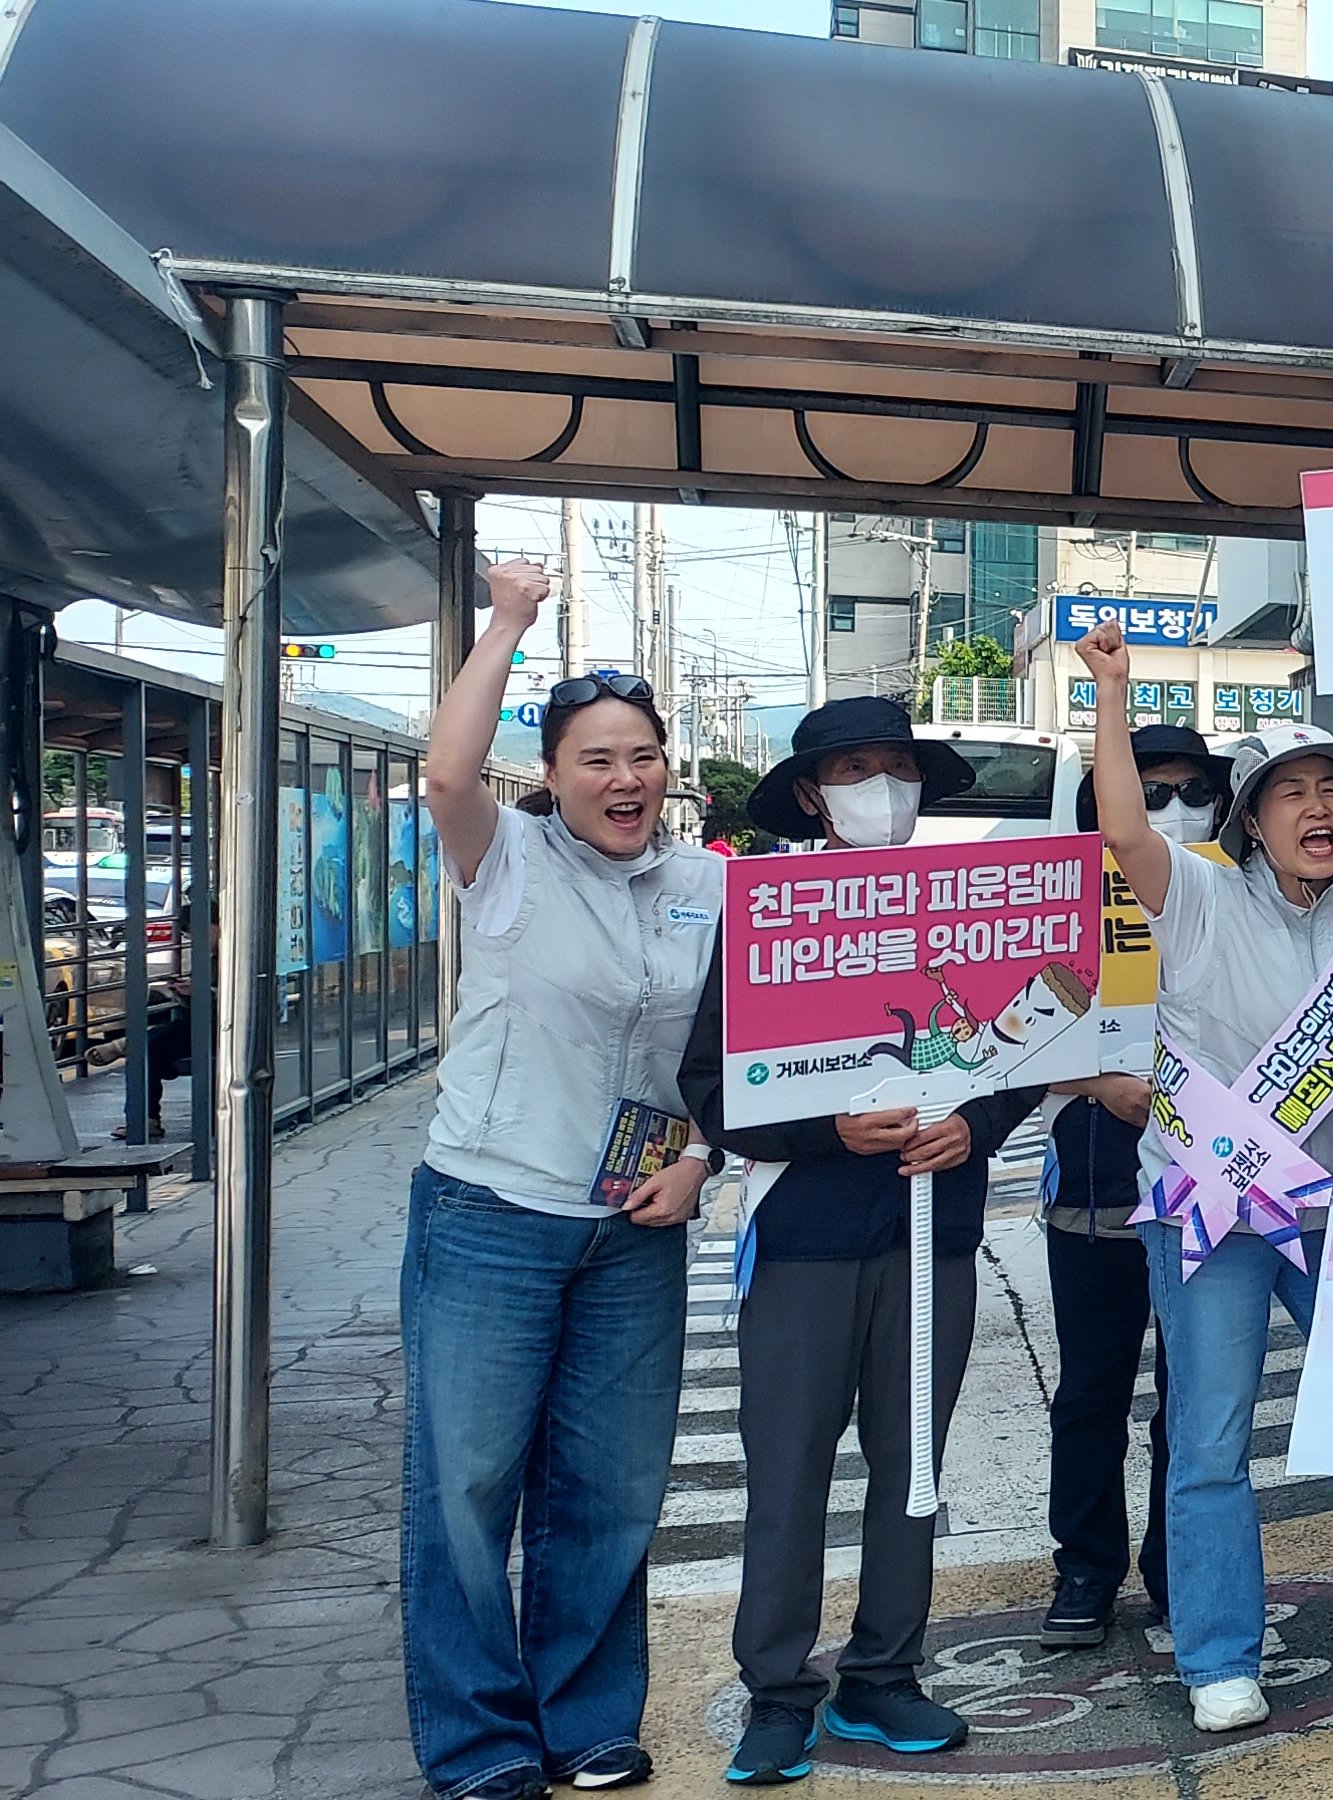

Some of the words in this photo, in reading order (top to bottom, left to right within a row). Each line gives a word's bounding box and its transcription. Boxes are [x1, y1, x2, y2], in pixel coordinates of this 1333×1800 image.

[748, 871, 920, 929] 친구따라
[926, 859, 1082, 913] 피운담배
[747, 928, 918, 986] 내인생을
[927, 912, 1083, 968] 앗아간다
[775, 1050, 873, 1080] 거제시보건소
[1221, 1138, 1261, 1179] 거제시
[1230, 1151, 1272, 1194] 보건소
